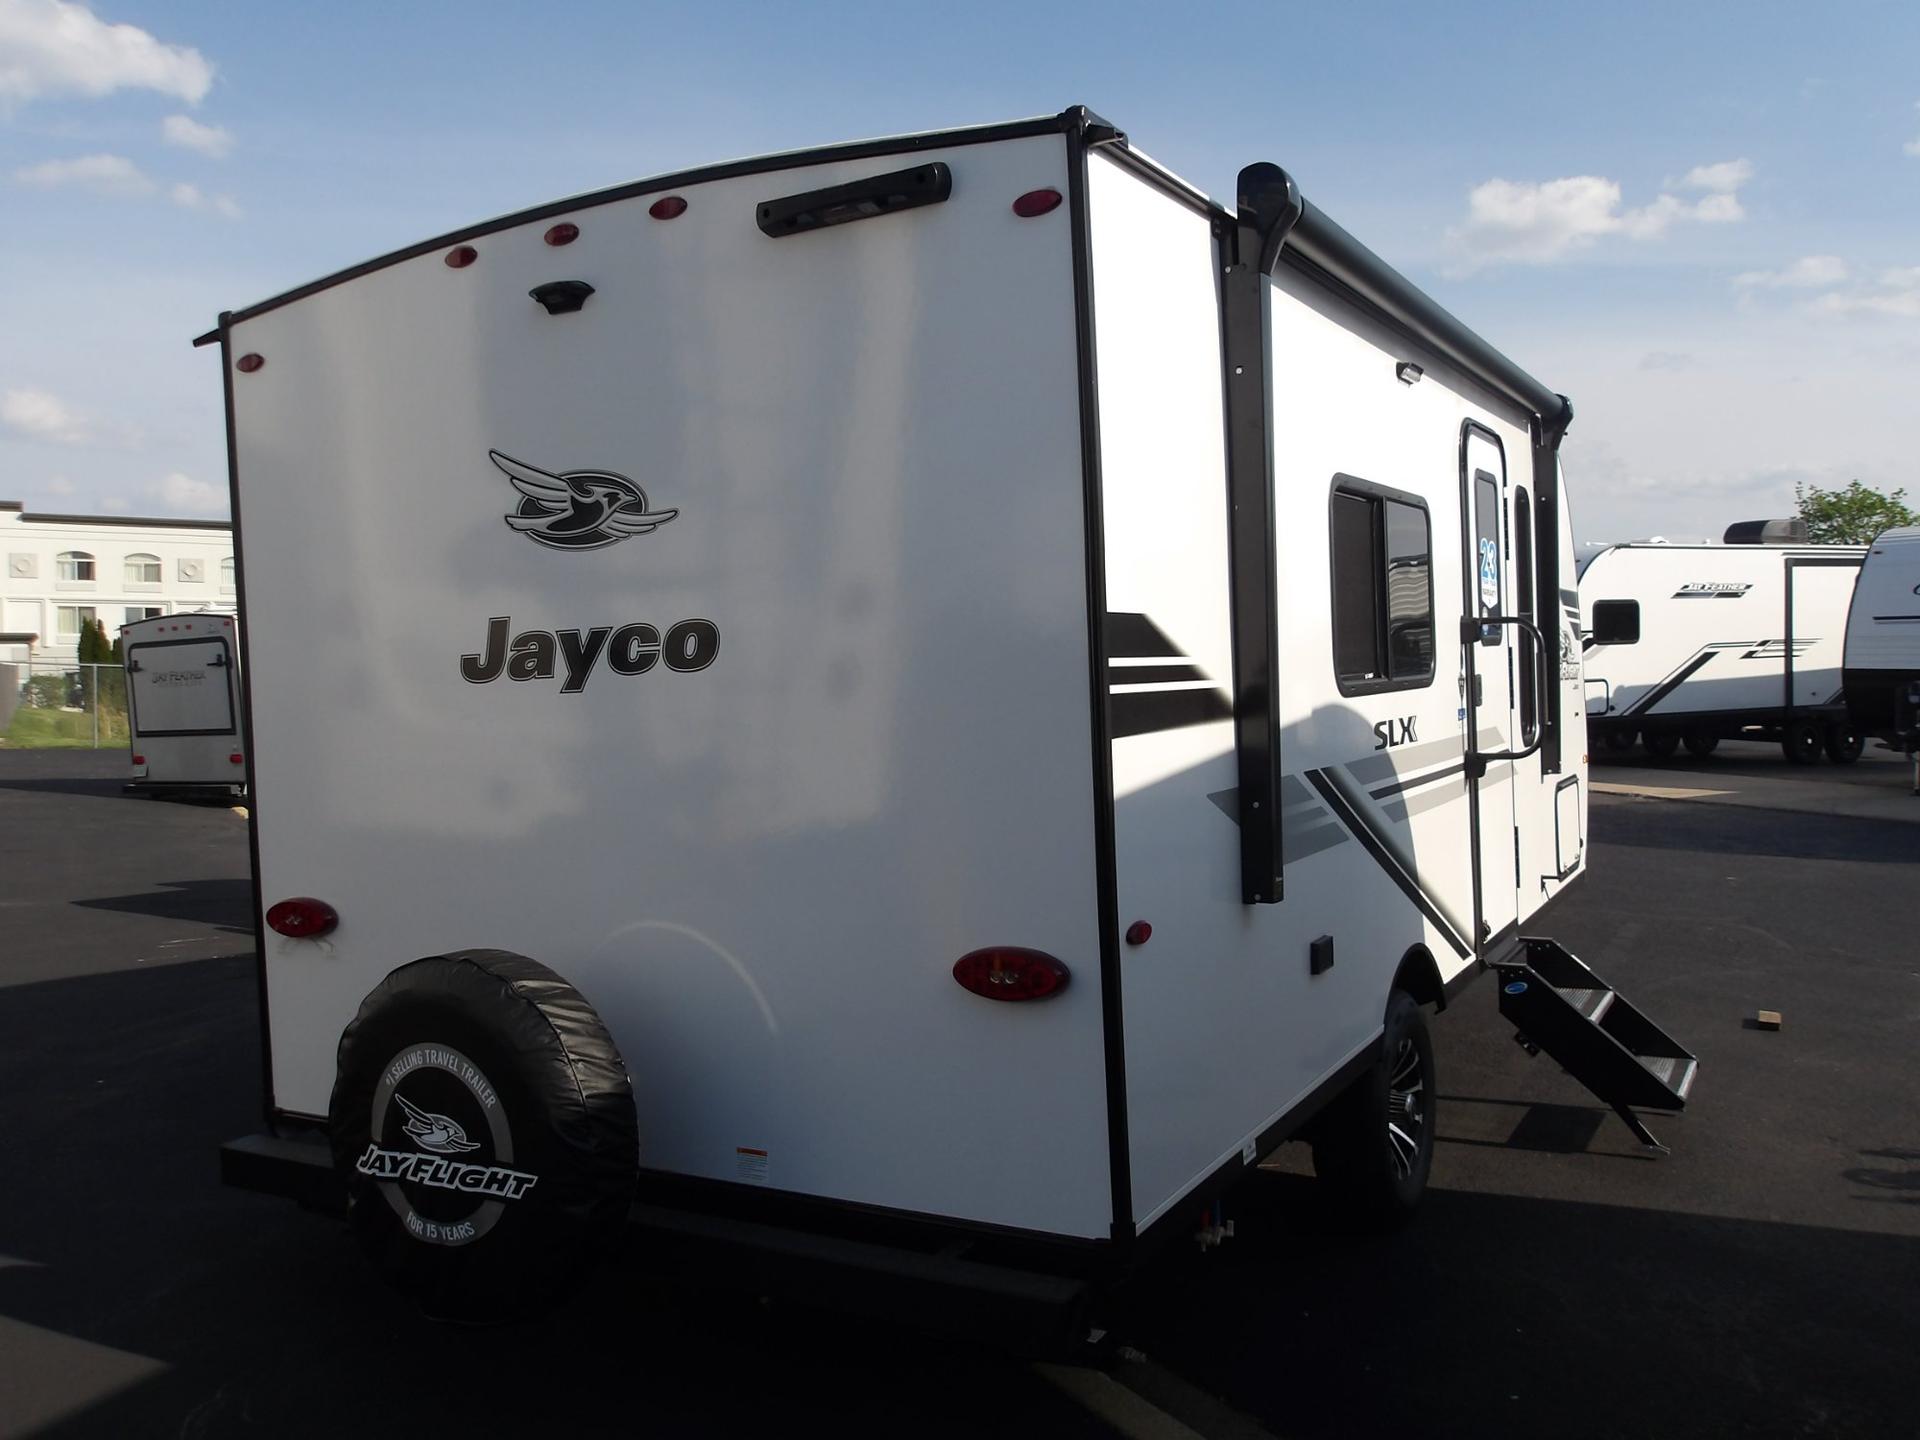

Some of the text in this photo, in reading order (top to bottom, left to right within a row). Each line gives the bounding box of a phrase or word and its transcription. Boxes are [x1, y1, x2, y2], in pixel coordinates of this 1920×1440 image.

[460, 616, 720, 693] Jayco
[1373, 715, 1418, 750] SLX
[391, 1050, 423, 1079] SELLING
[424, 1049, 459, 1072] TRAVEL
[461, 1063, 497, 1108] TRAILER
[406, 1211, 476, 1241] FOR 15 YEARS
